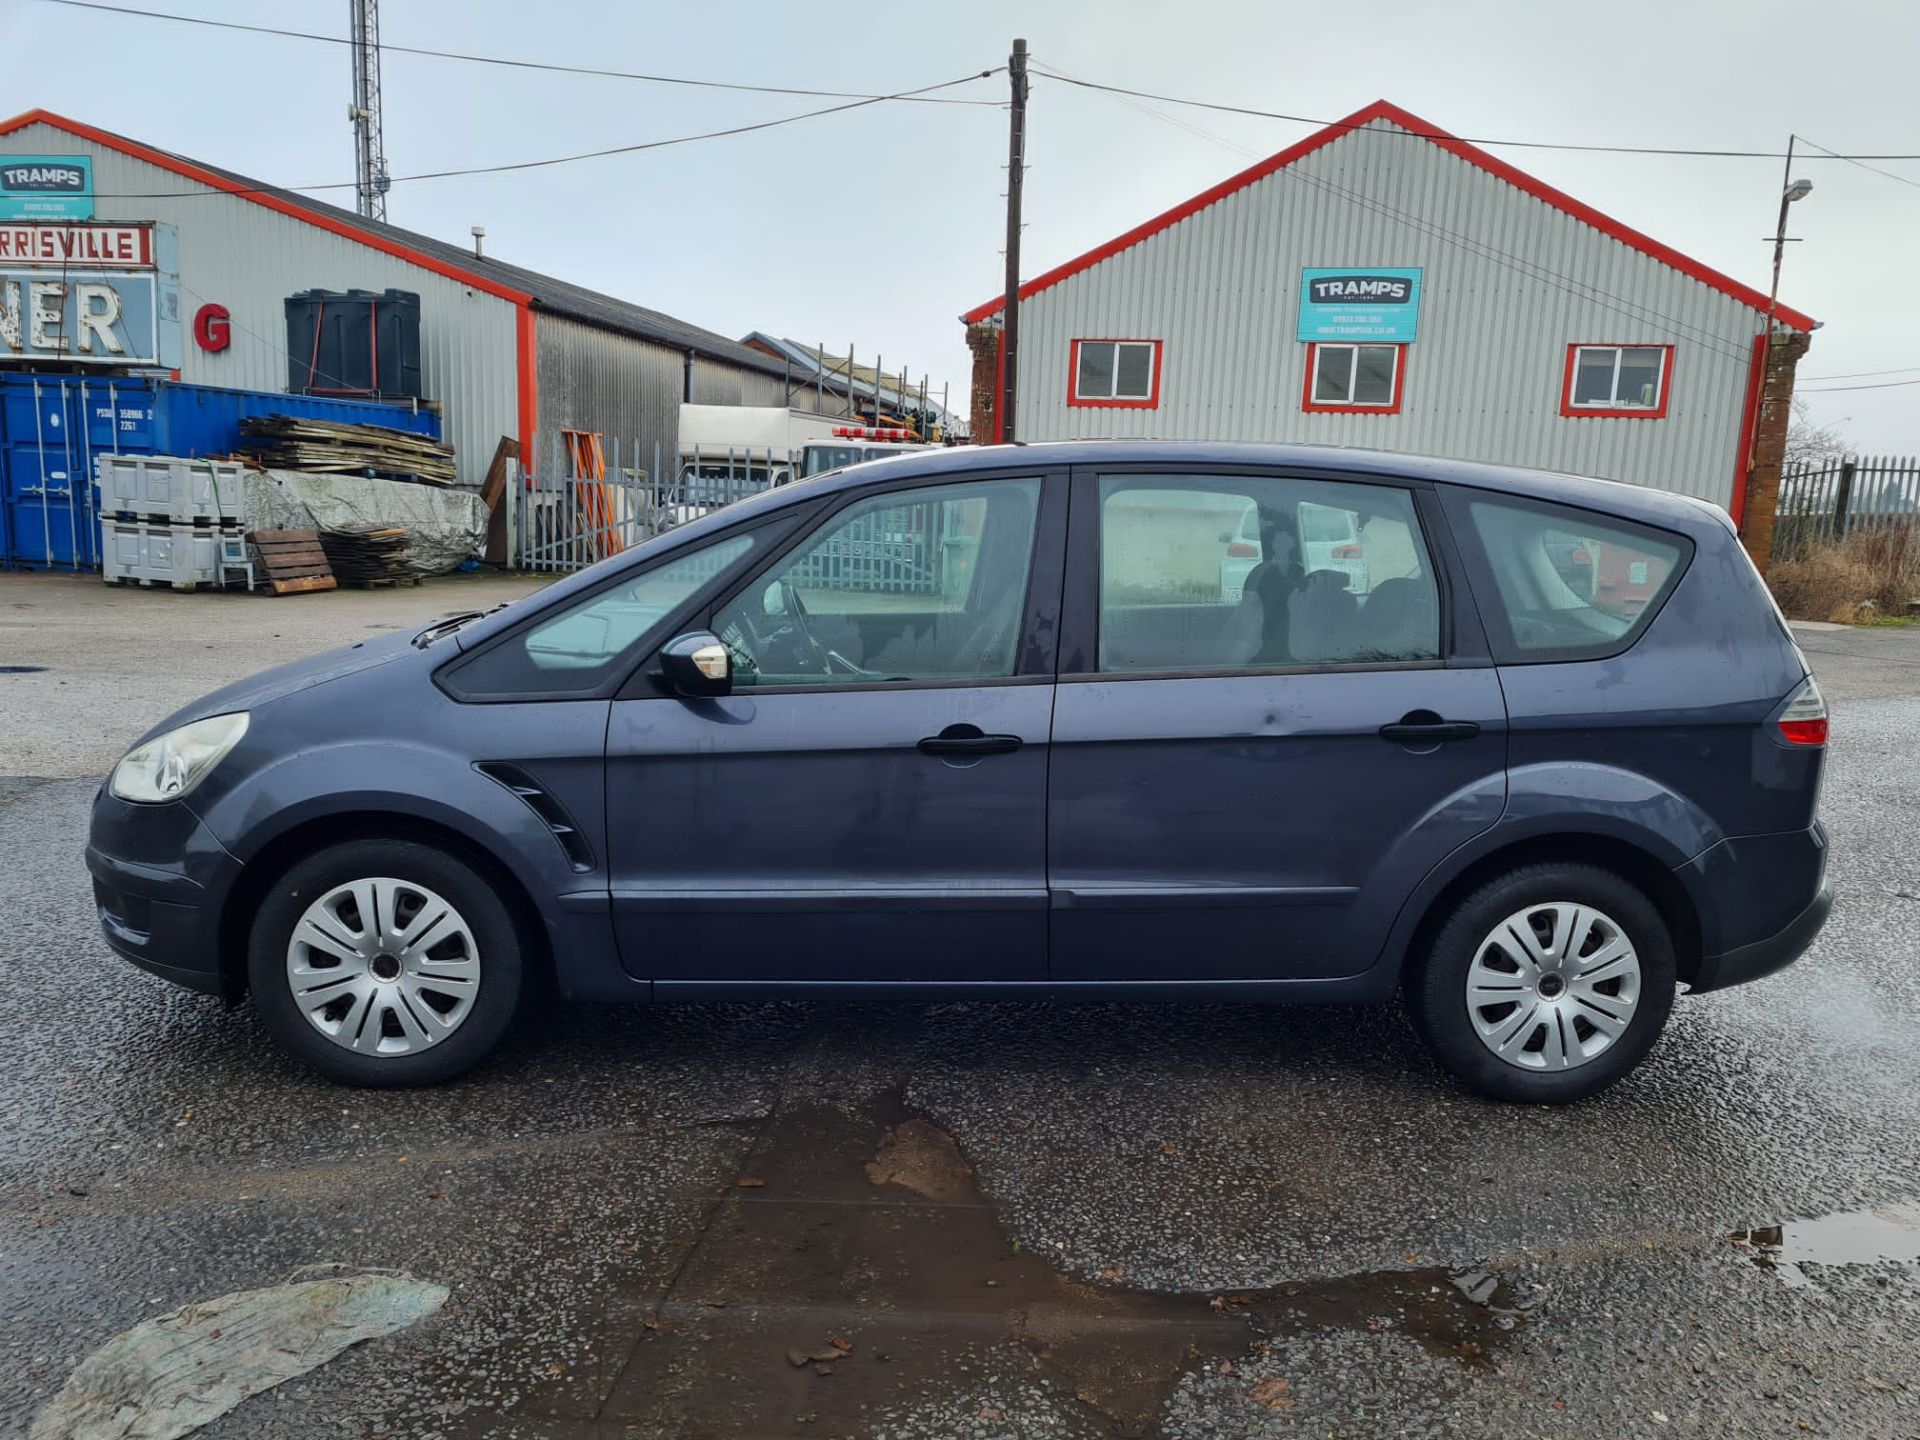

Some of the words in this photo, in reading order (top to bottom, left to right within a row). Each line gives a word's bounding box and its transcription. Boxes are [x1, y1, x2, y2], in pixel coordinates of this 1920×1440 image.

[4, 168, 80, 186] TRAMPS
[1315, 281, 1405, 298] TRAMPS
[194, 303, 231, 352] G
[147, 409, 153, 419] 2
